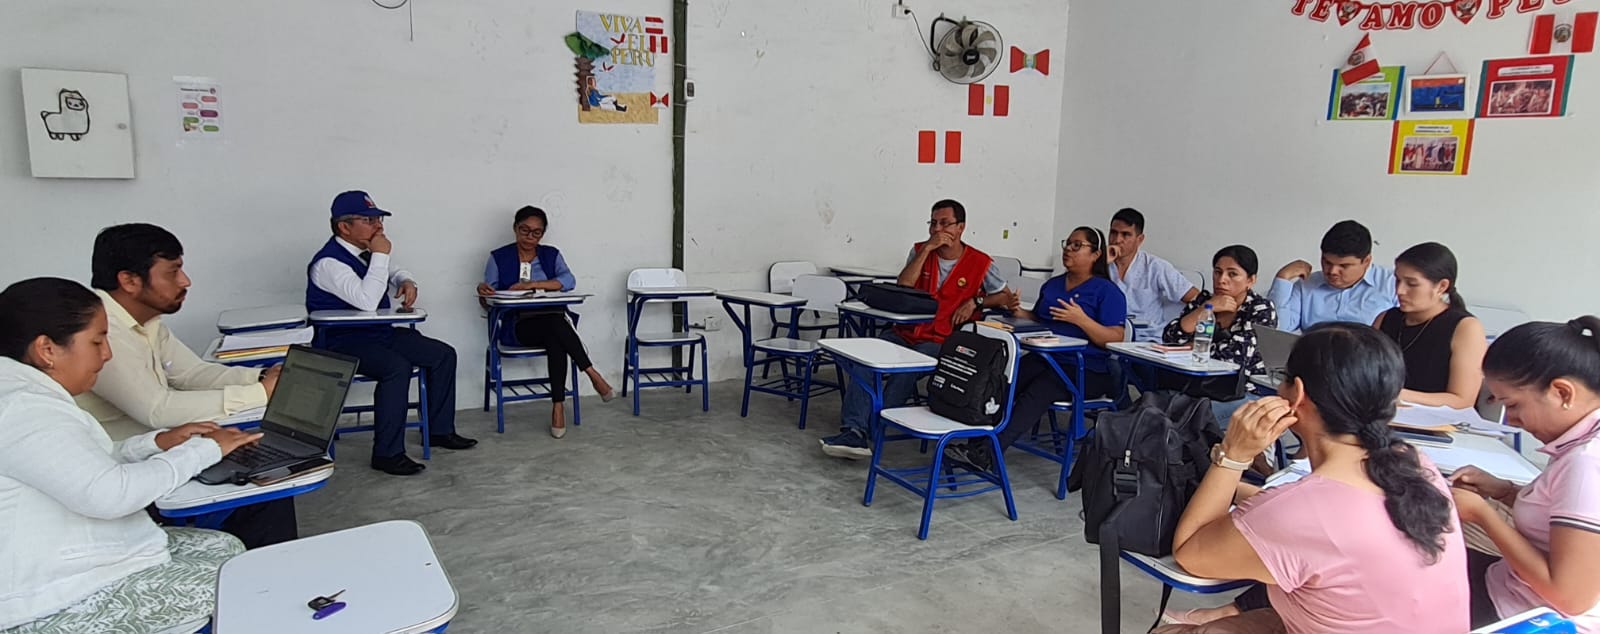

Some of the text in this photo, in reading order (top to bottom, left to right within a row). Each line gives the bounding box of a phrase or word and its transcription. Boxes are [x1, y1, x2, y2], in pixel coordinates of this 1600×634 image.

[600, 14, 643, 33] VIVA
[1291, 0, 1331, 22] TE
[1359, 1, 1446, 30] AMO
[628, 34, 648, 52] EL
[612, 47, 655, 68] PERU
